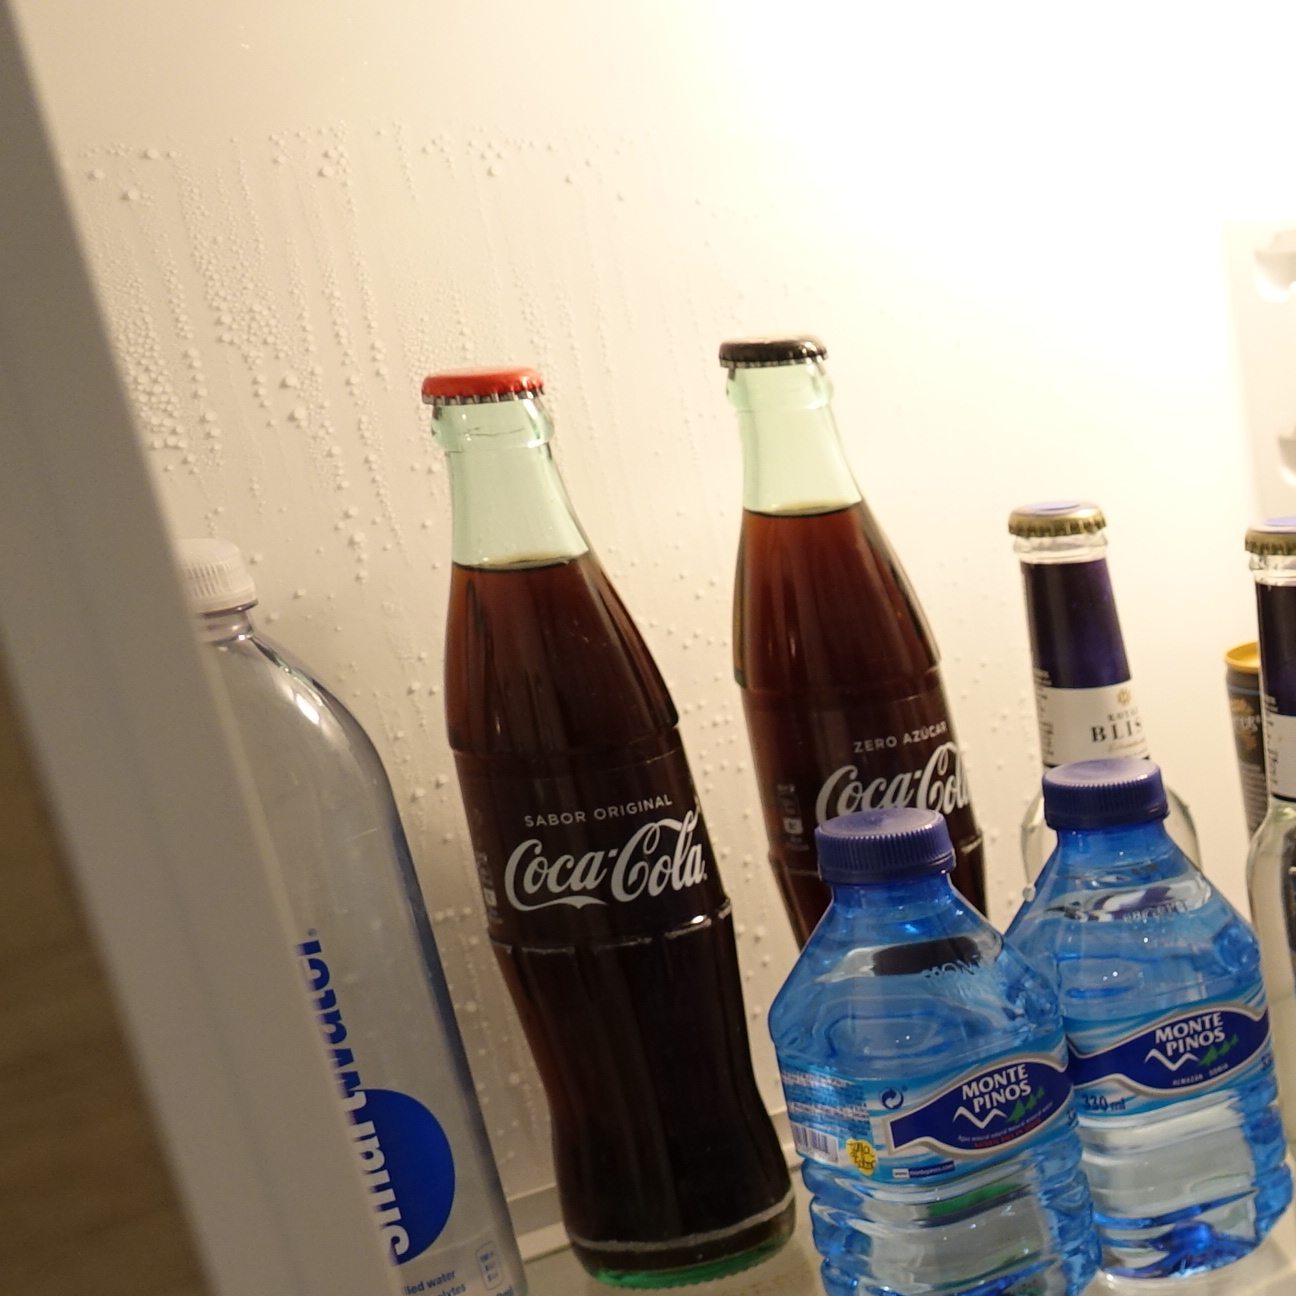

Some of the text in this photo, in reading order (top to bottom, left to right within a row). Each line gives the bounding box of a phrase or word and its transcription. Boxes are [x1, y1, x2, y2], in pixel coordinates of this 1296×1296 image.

[852, 720, 948, 753] ZERO AZÚCAR
[523, 793, 673, 828] SABOR ORIGINAL
[504, 796, 707, 912] Coca-Cola
[1154, 1011, 1224, 1045] MONTE
[1165, 1027, 1226, 1057] PINOS
[960, 1062, 1029, 1101] MONTE
[972, 1079, 1032, 1114] PINOS
[1081, 1094, 1127, 1111] 330 ml
